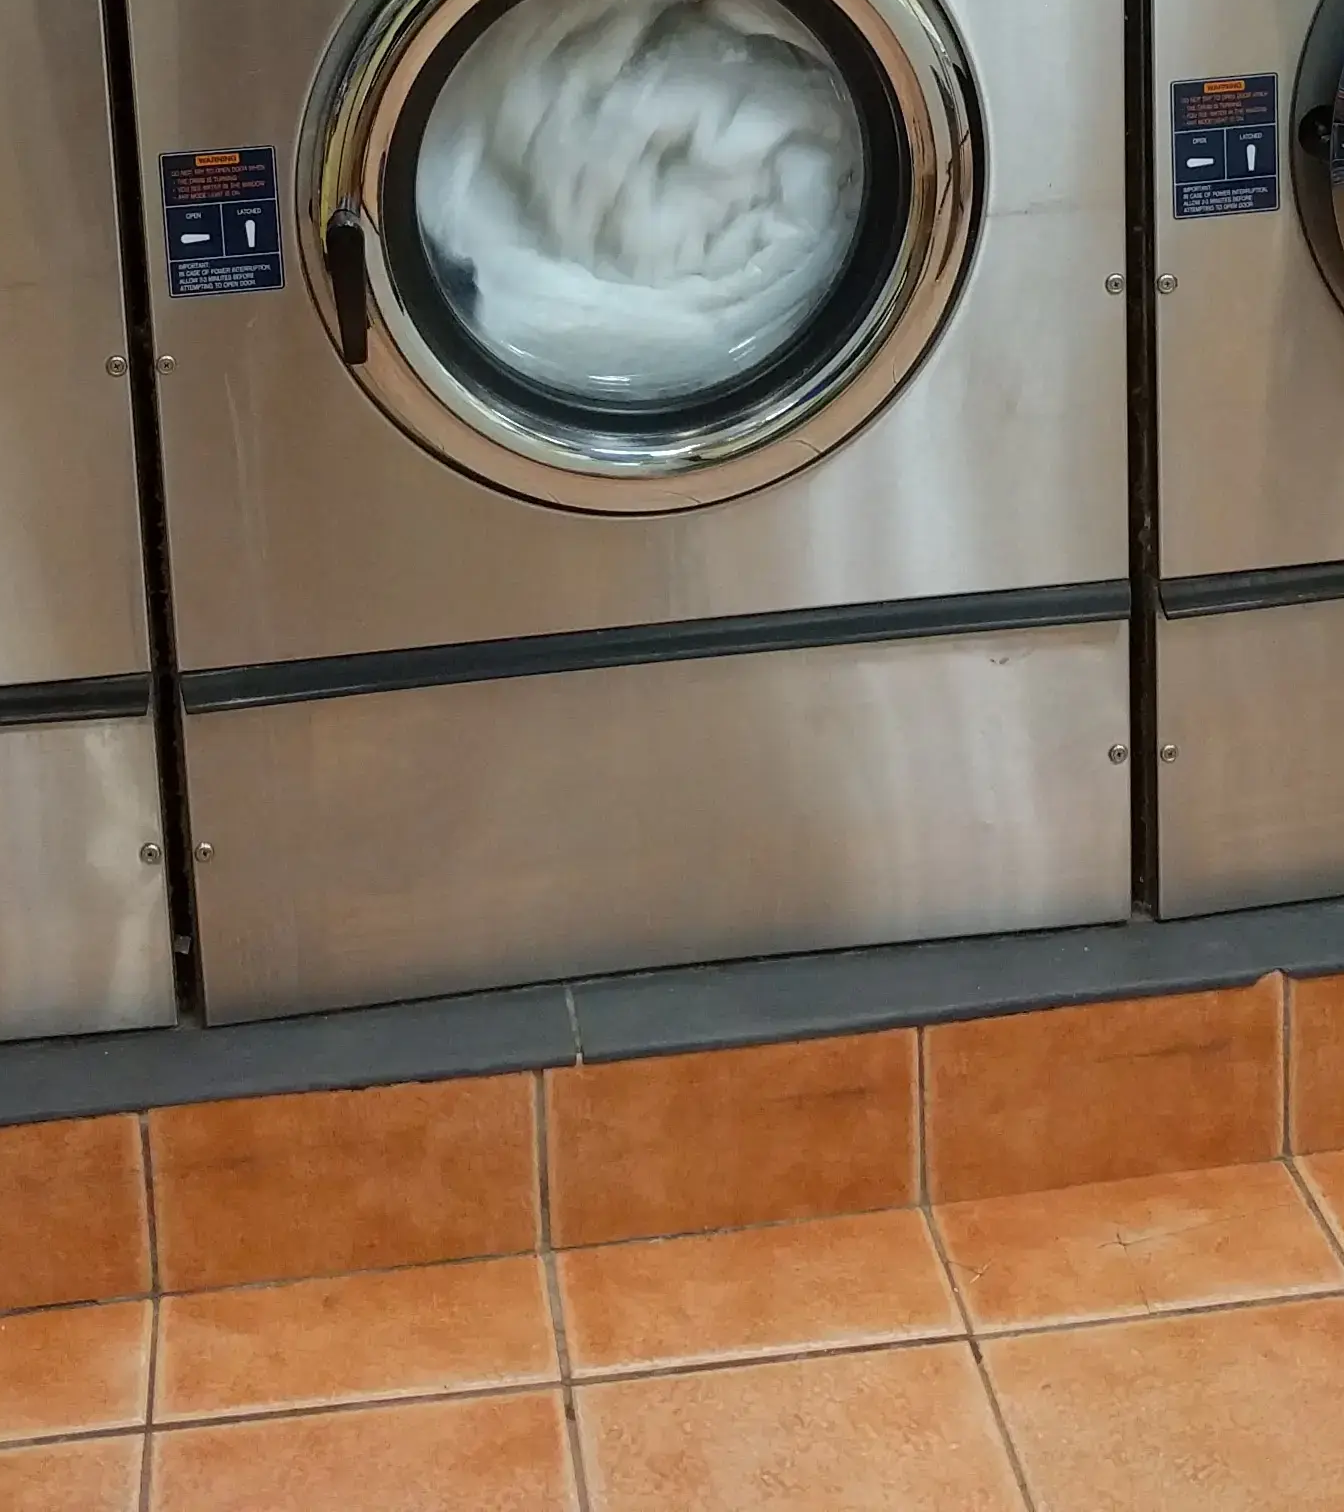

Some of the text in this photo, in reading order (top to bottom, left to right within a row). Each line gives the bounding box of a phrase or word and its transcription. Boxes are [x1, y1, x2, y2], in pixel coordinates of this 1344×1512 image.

[198, 154, 237, 164] WARNING
[185, 212, 202, 220] OPEN
[236, 207, 262, 216] LATCHED
